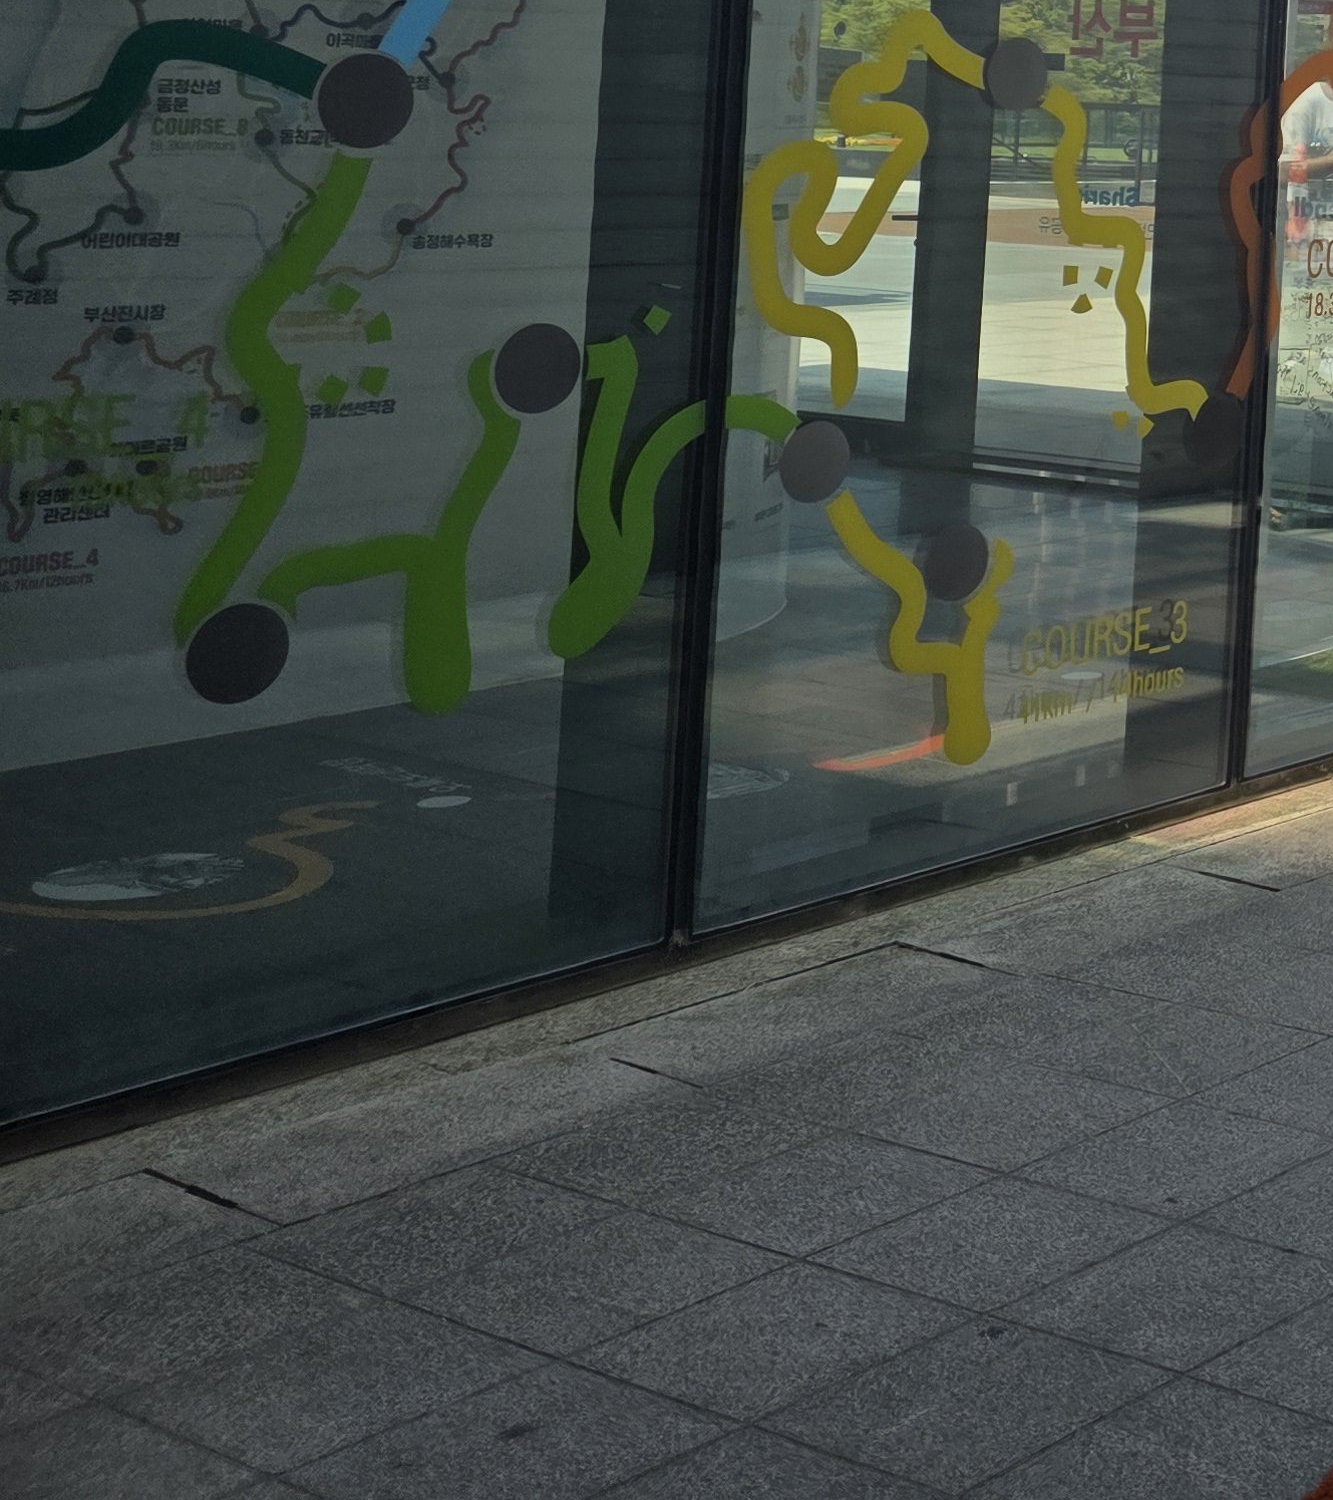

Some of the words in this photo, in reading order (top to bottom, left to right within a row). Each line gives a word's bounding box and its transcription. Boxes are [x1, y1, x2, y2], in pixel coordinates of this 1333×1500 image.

[80, 231, 181, 249] 어린이대공원
[412, 233, 494, 250] 송정해수욕장
[84, 303, 166, 323] 부산진시장
[1022, 600, 1188, 676] COURSE_3
